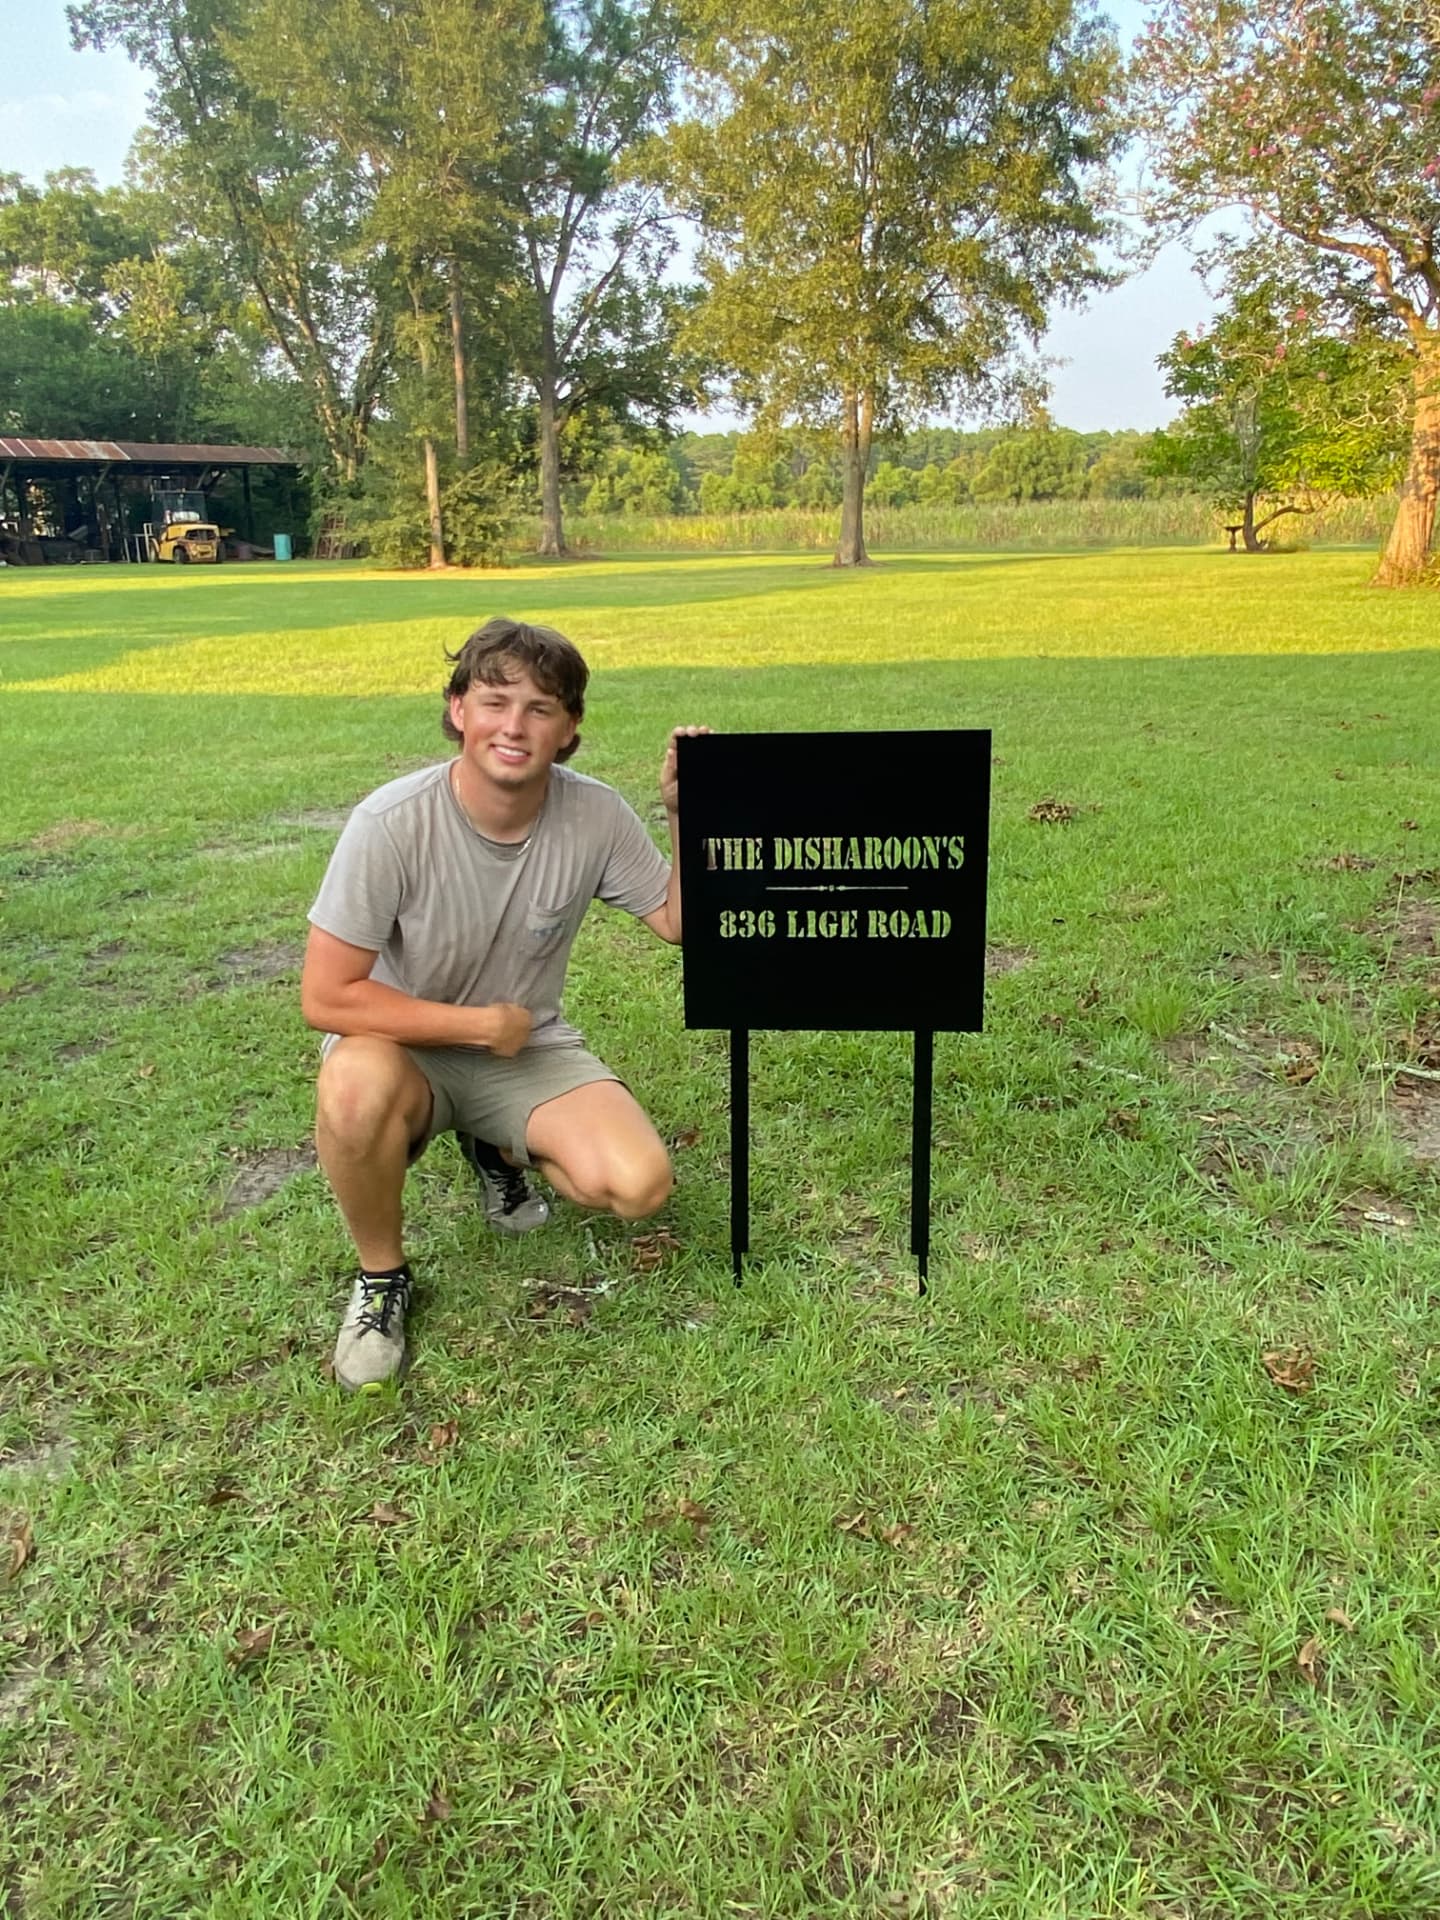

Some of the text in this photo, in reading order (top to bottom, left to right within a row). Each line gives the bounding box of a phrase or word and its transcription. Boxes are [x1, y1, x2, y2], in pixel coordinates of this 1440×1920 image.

[702, 835, 966, 871] THE DISHAROON'S
[719, 909, 953, 938] 836 LIGE ROAD
